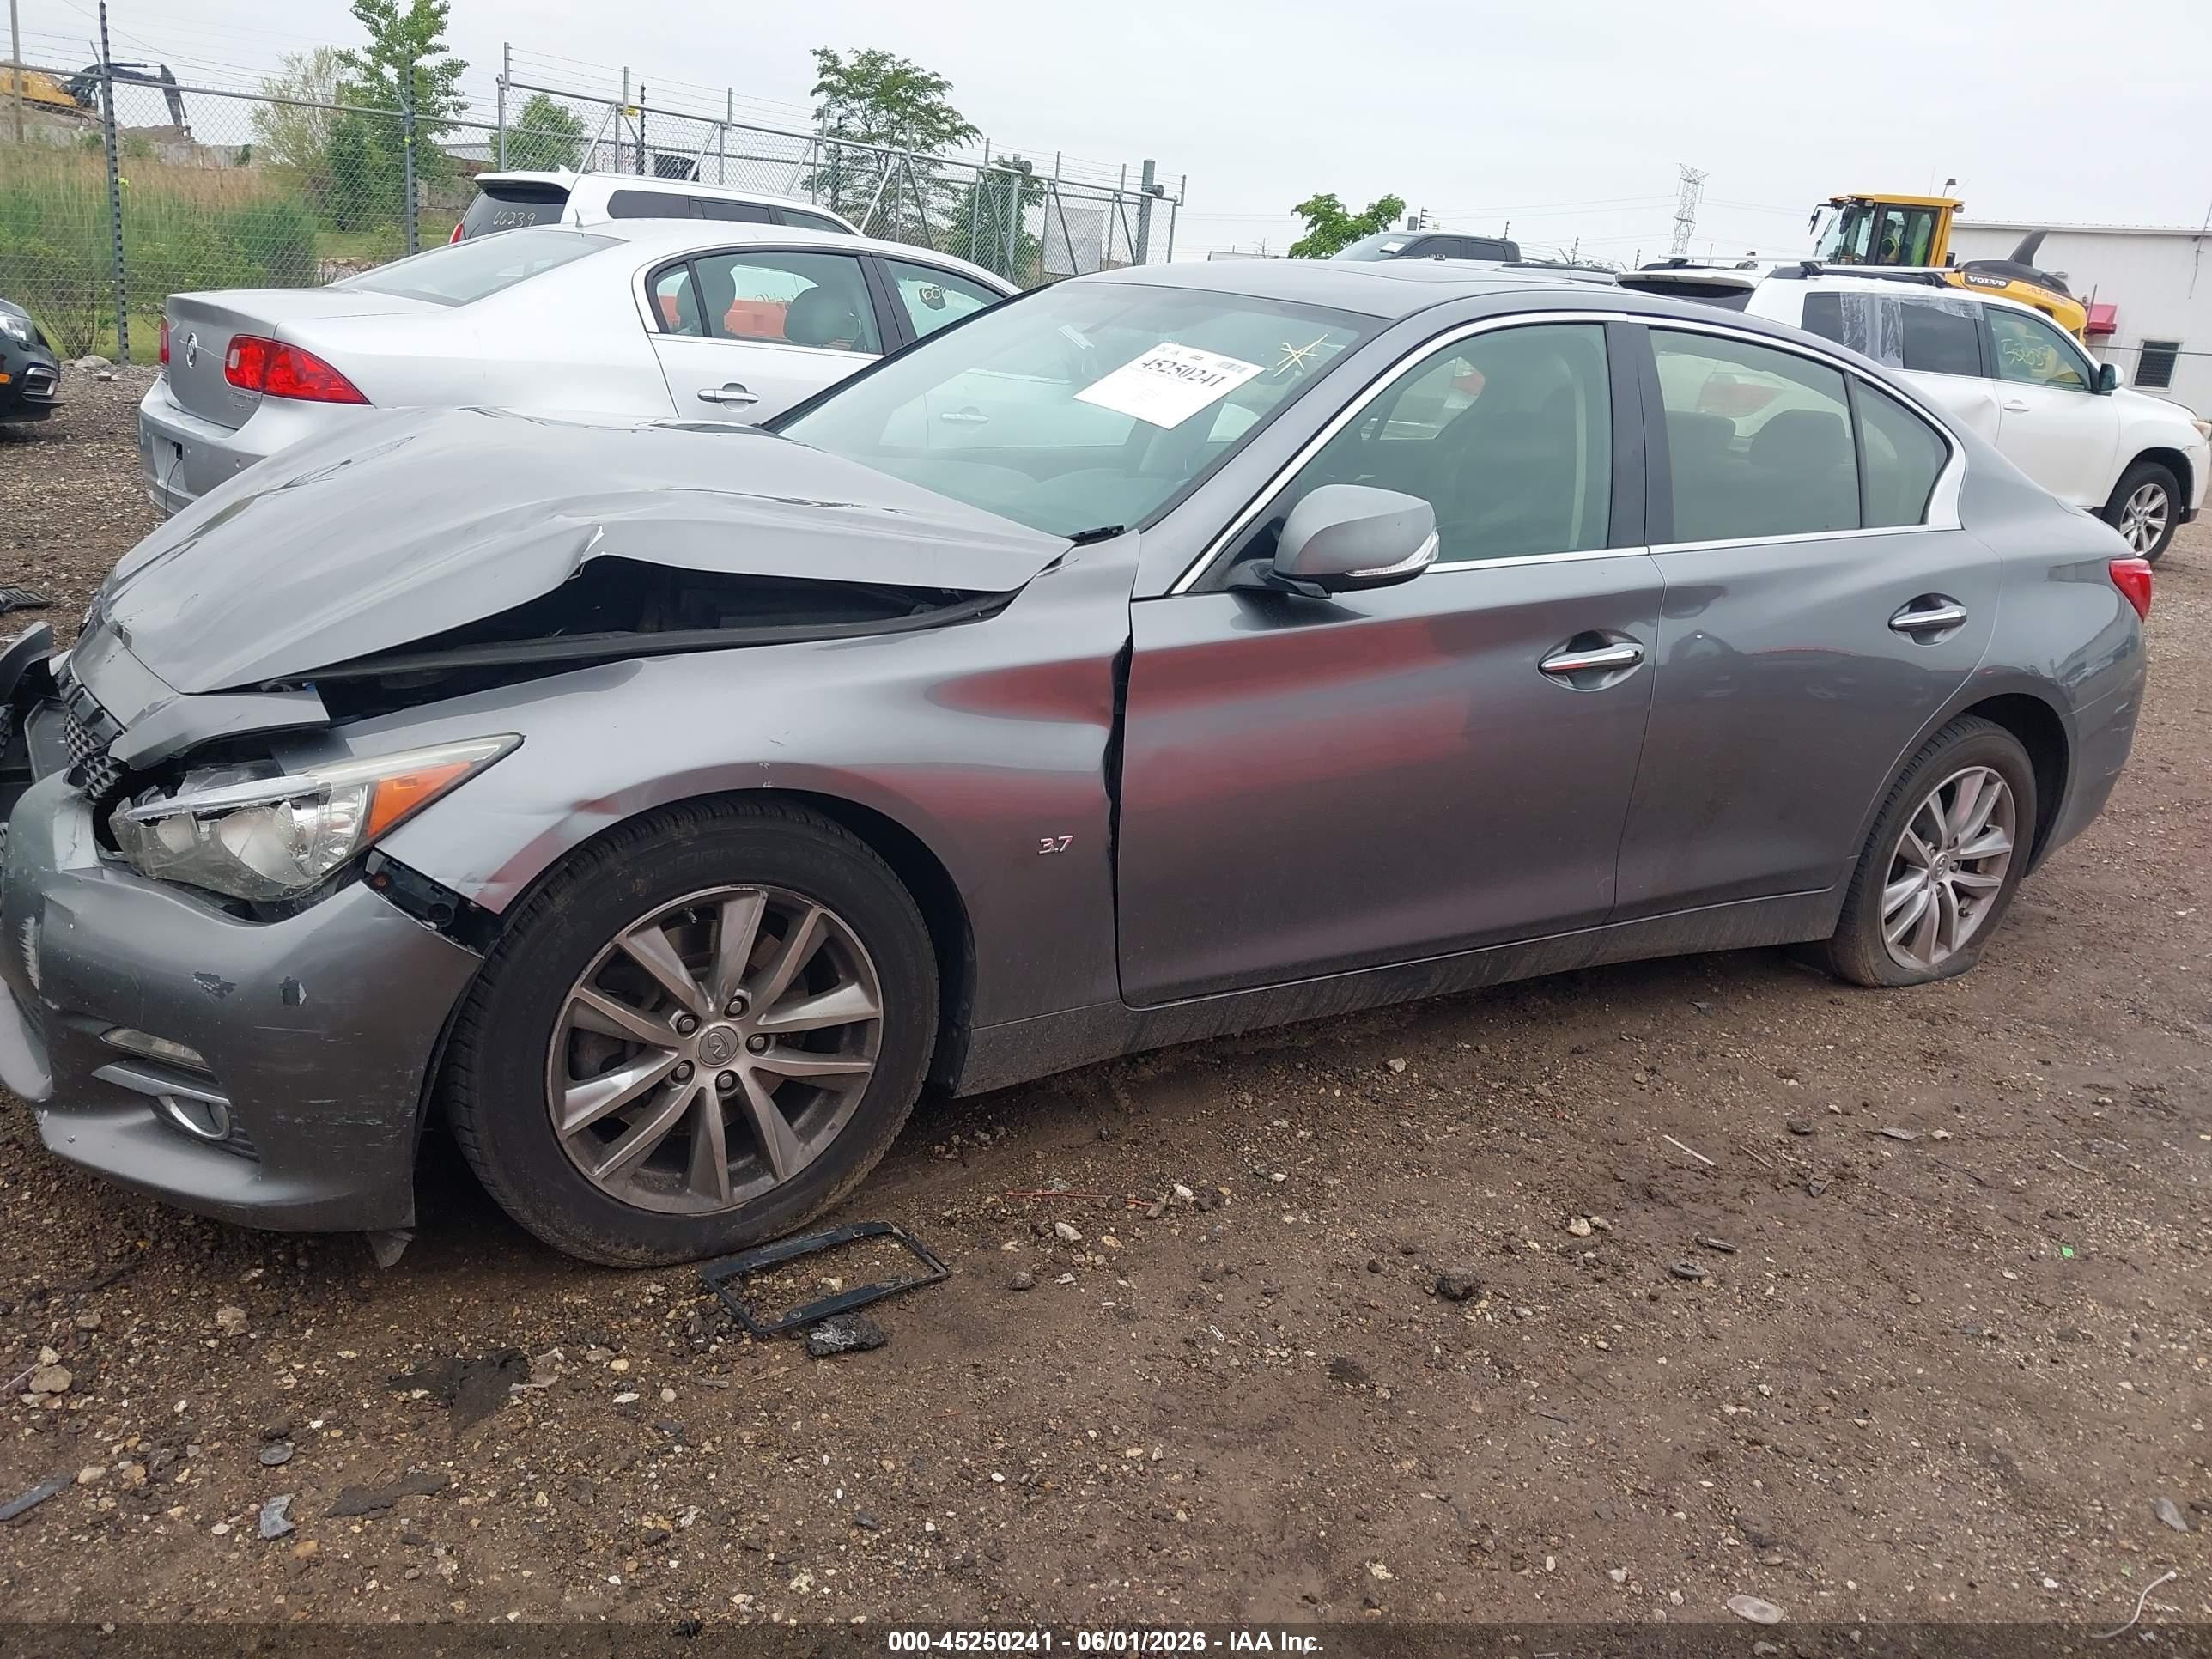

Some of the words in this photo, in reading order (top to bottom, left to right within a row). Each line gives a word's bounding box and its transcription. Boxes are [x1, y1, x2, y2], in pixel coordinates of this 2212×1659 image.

[494, 210, 537, 228] 66239
[1967, 276, 2007, 287] VOLVO
[1141, 357, 1227, 387] 45250241
[1038, 835, 1073, 855] 3.7
